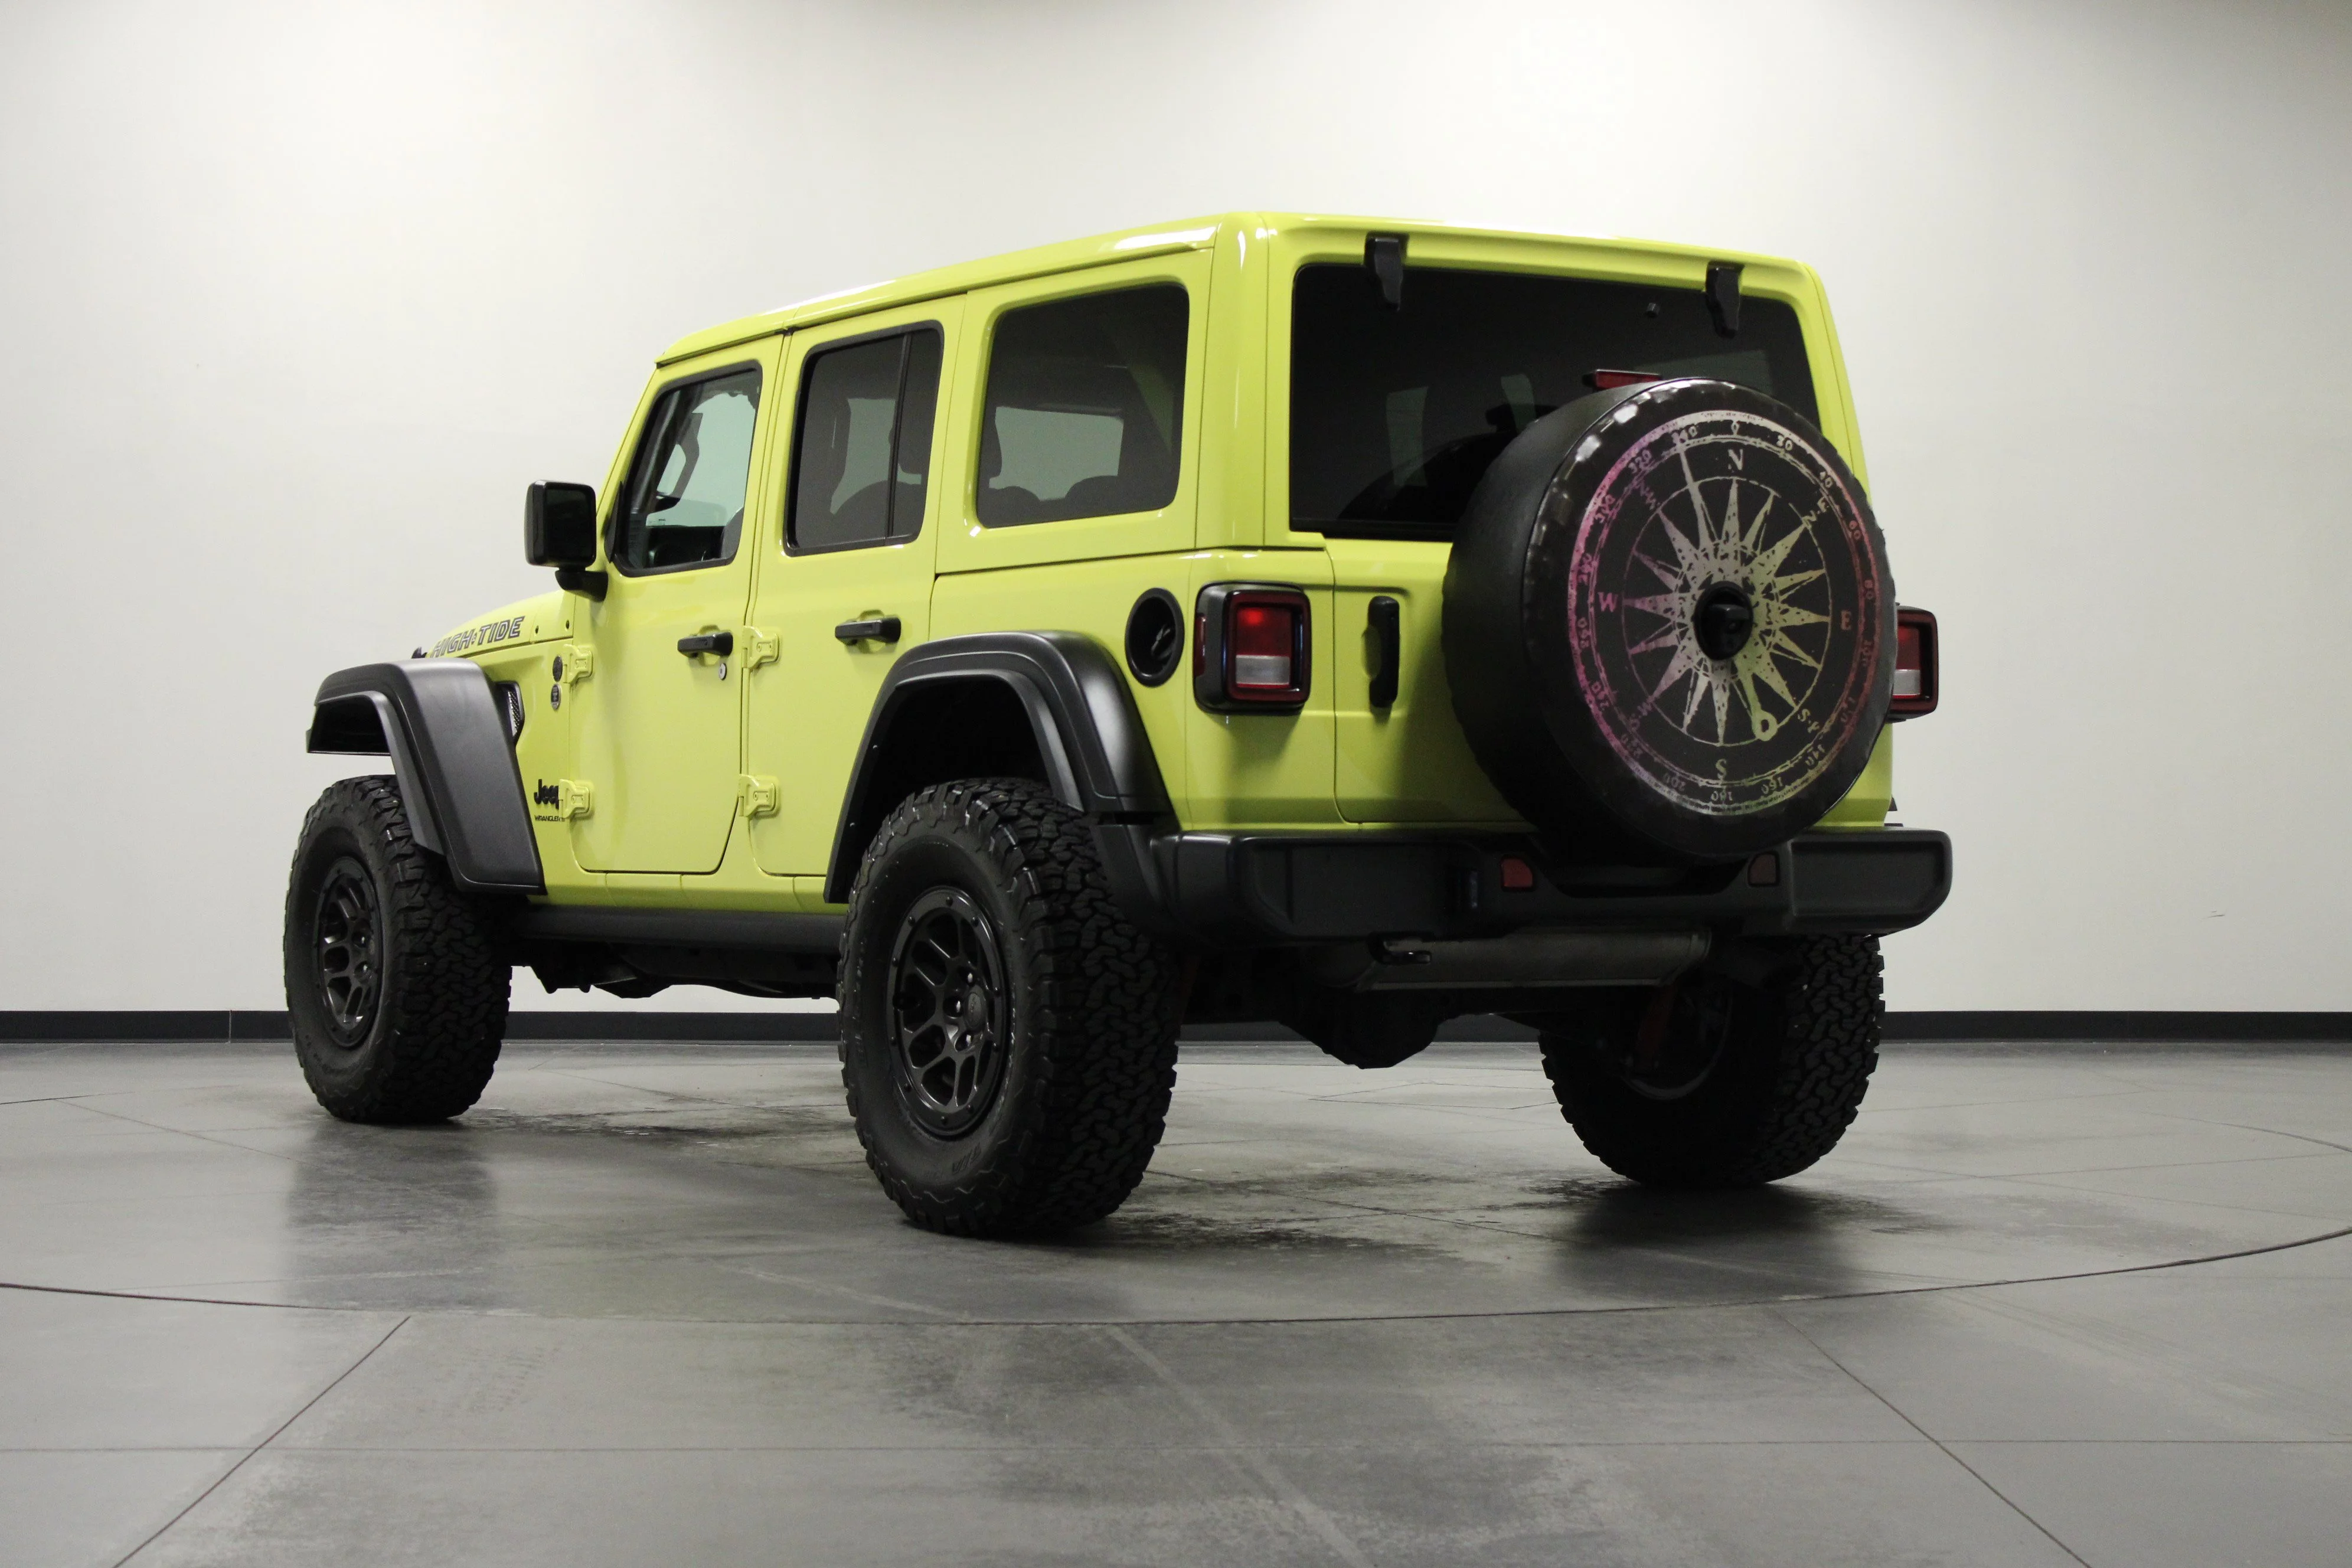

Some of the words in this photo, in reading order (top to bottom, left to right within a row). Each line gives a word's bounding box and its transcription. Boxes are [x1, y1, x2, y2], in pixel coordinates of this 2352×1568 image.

[1728, 449, 1744, 471] N
[1598, 592, 1619, 613] W
[1841, 610, 1852, 631] E
[430, 629, 475, 658] HIGH
[477, 616, 525, 646] TIDE
[1715, 758, 1727, 782] S
